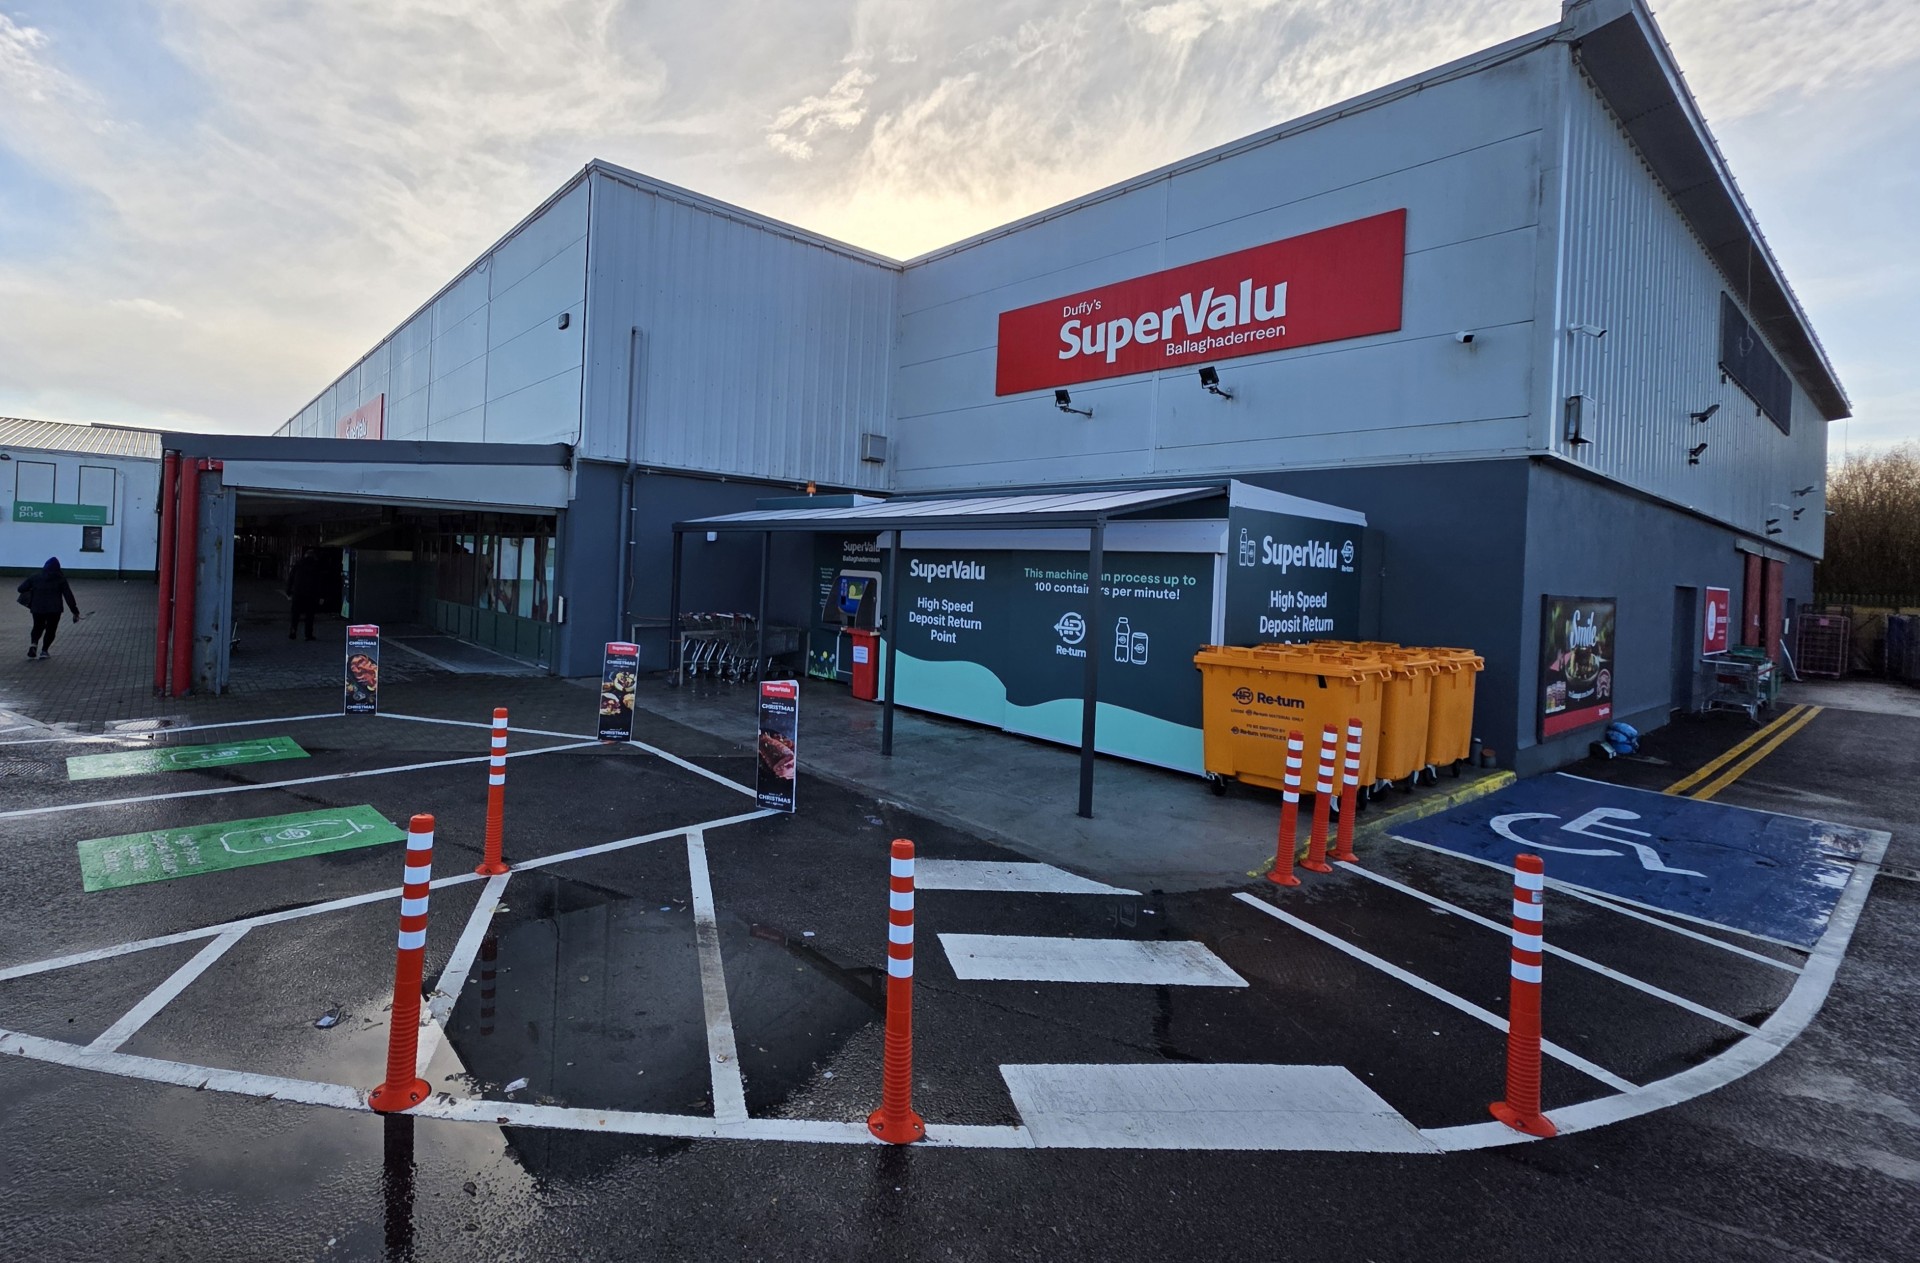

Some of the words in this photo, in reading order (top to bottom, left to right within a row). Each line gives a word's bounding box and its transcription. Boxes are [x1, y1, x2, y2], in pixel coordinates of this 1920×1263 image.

[1063, 299, 1102, 318] Duffy's
[1058, 278, 1288, 364] SuperValu
[1166, 325, 1286, 356] Ballaghaderreen
[1261, 535, 1338, 575] SuperValu
[909, 558, 986, 584] SuperValu
[1024, 567, 1044, 579] This
[1045, 568, 1089, 581] machine
[1113, 572, 1160, 585] process
[1163, 575, 1180, 588] up
[1182, 574, 1197, 586] to
[1034, 581, 1052, 592] 100
[1112, 586, 1132, 598] per
[1134, 586, 1181, 600] minute!
[1270, 589, 1295, 612] High
[1296, 591, 1328, 612] Speed
[917, 597, 940, 612] High
[941, 598, 974, 614] Speed
[908, 611, 946, 627] Deposit
[947, 615, 982, 631] Return
[1259, 615, 1301, 638] Deposit
[1302, 615, 1334, 632] Return
[1569, 609, 1597, 649] Smile
[930, 629, 957, 644] Point
[1055, 644, 1087, 658] Re-turn
[761, 703, 795, 712] CHRISTMAS
[1257, 692, 1305, 709] Re-turn
